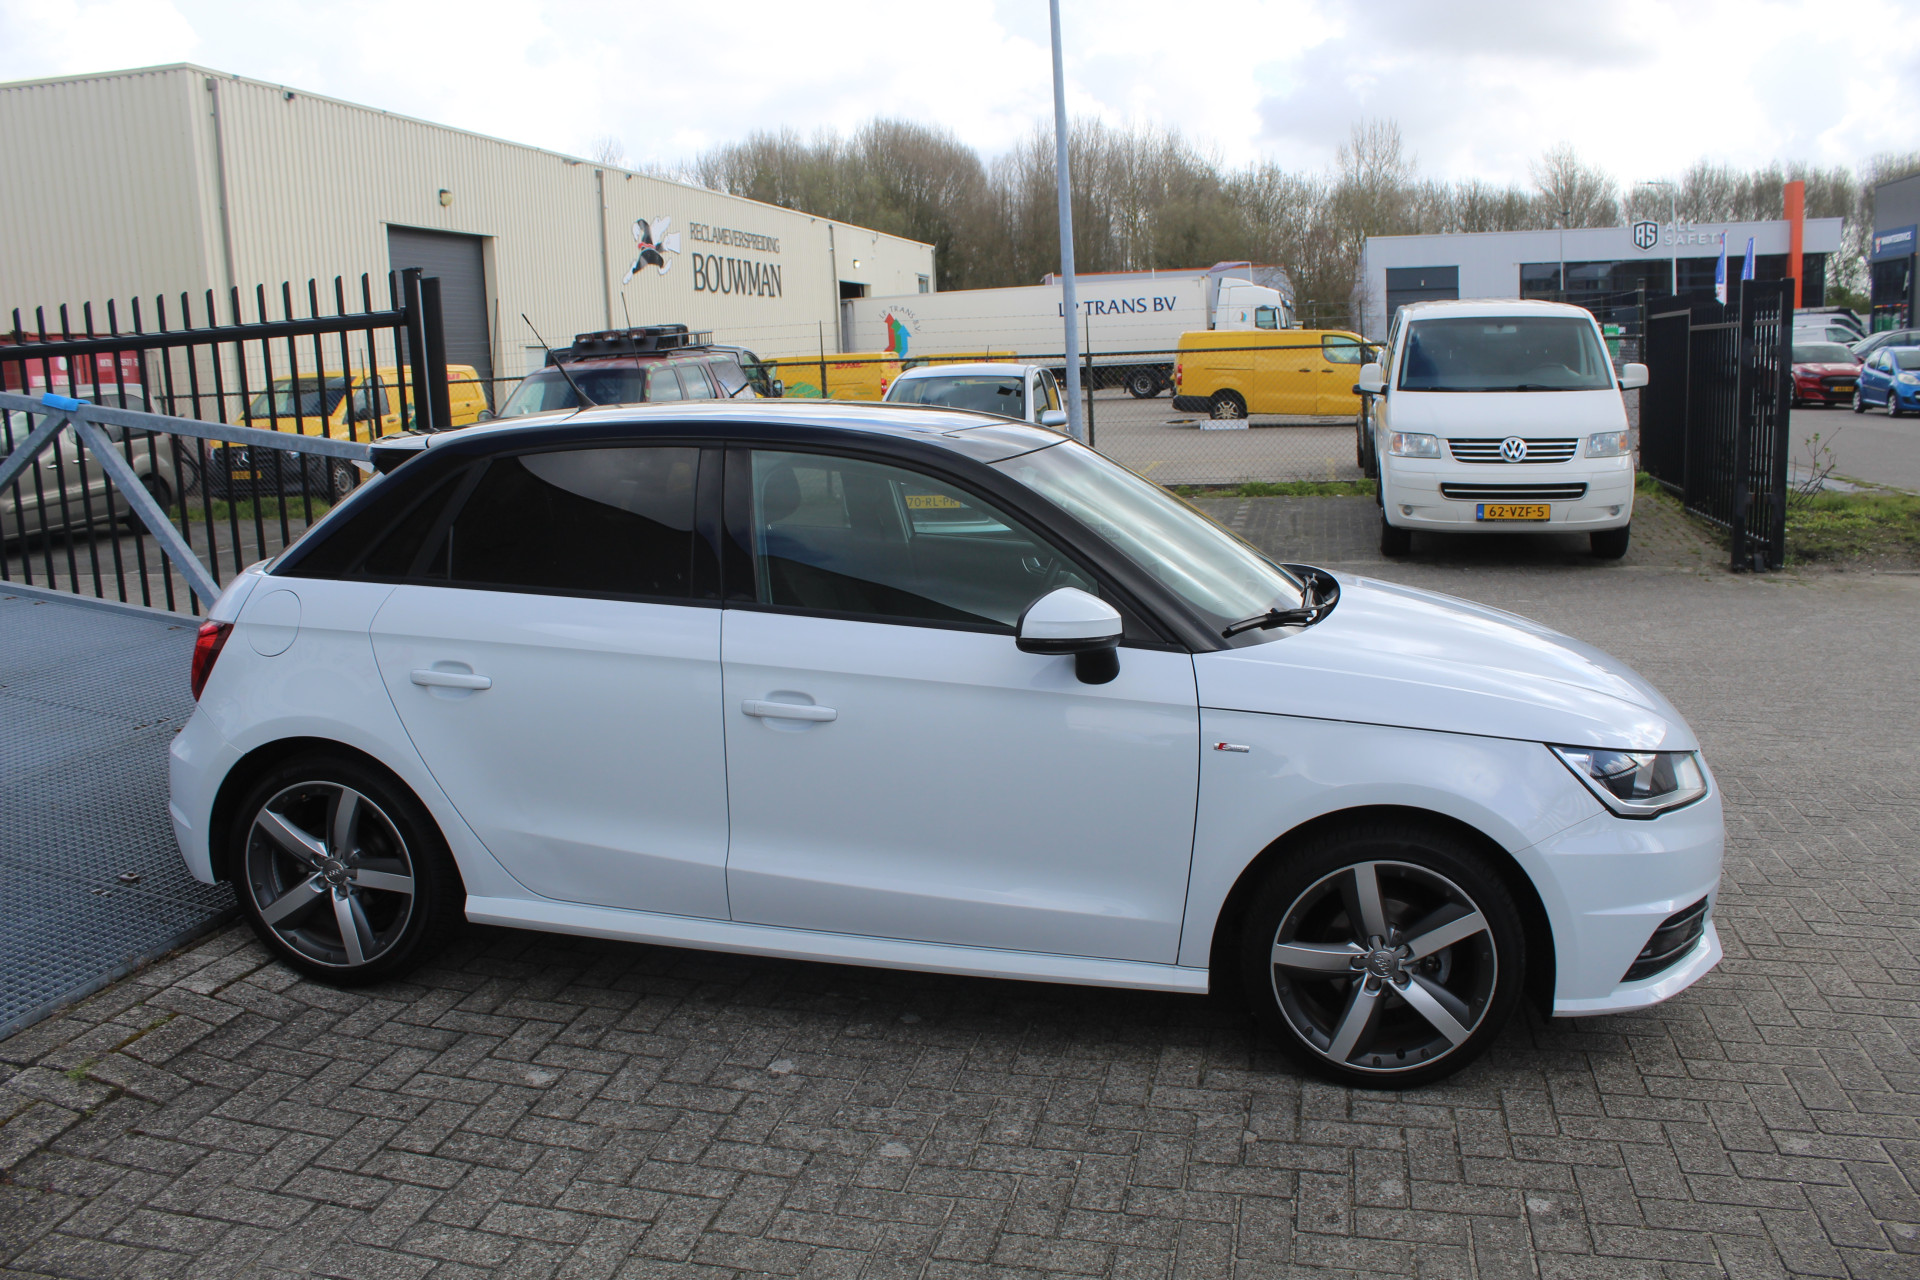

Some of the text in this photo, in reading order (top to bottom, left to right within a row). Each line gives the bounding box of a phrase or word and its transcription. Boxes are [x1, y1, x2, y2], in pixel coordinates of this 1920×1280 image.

[1665, 220, 1696, 232] ALL
[690, 222, 780, 254] RECLAMEVERSPREIDING
[692, 252, 782, 298] BOUWMAN
[889, 305, 915, 319] TRANS
[1084, 297, 1148, 316] TRANS
[1153, 296, 1177, 312] BV
[1489, 506, 1545, 517] 62-VZF-5
